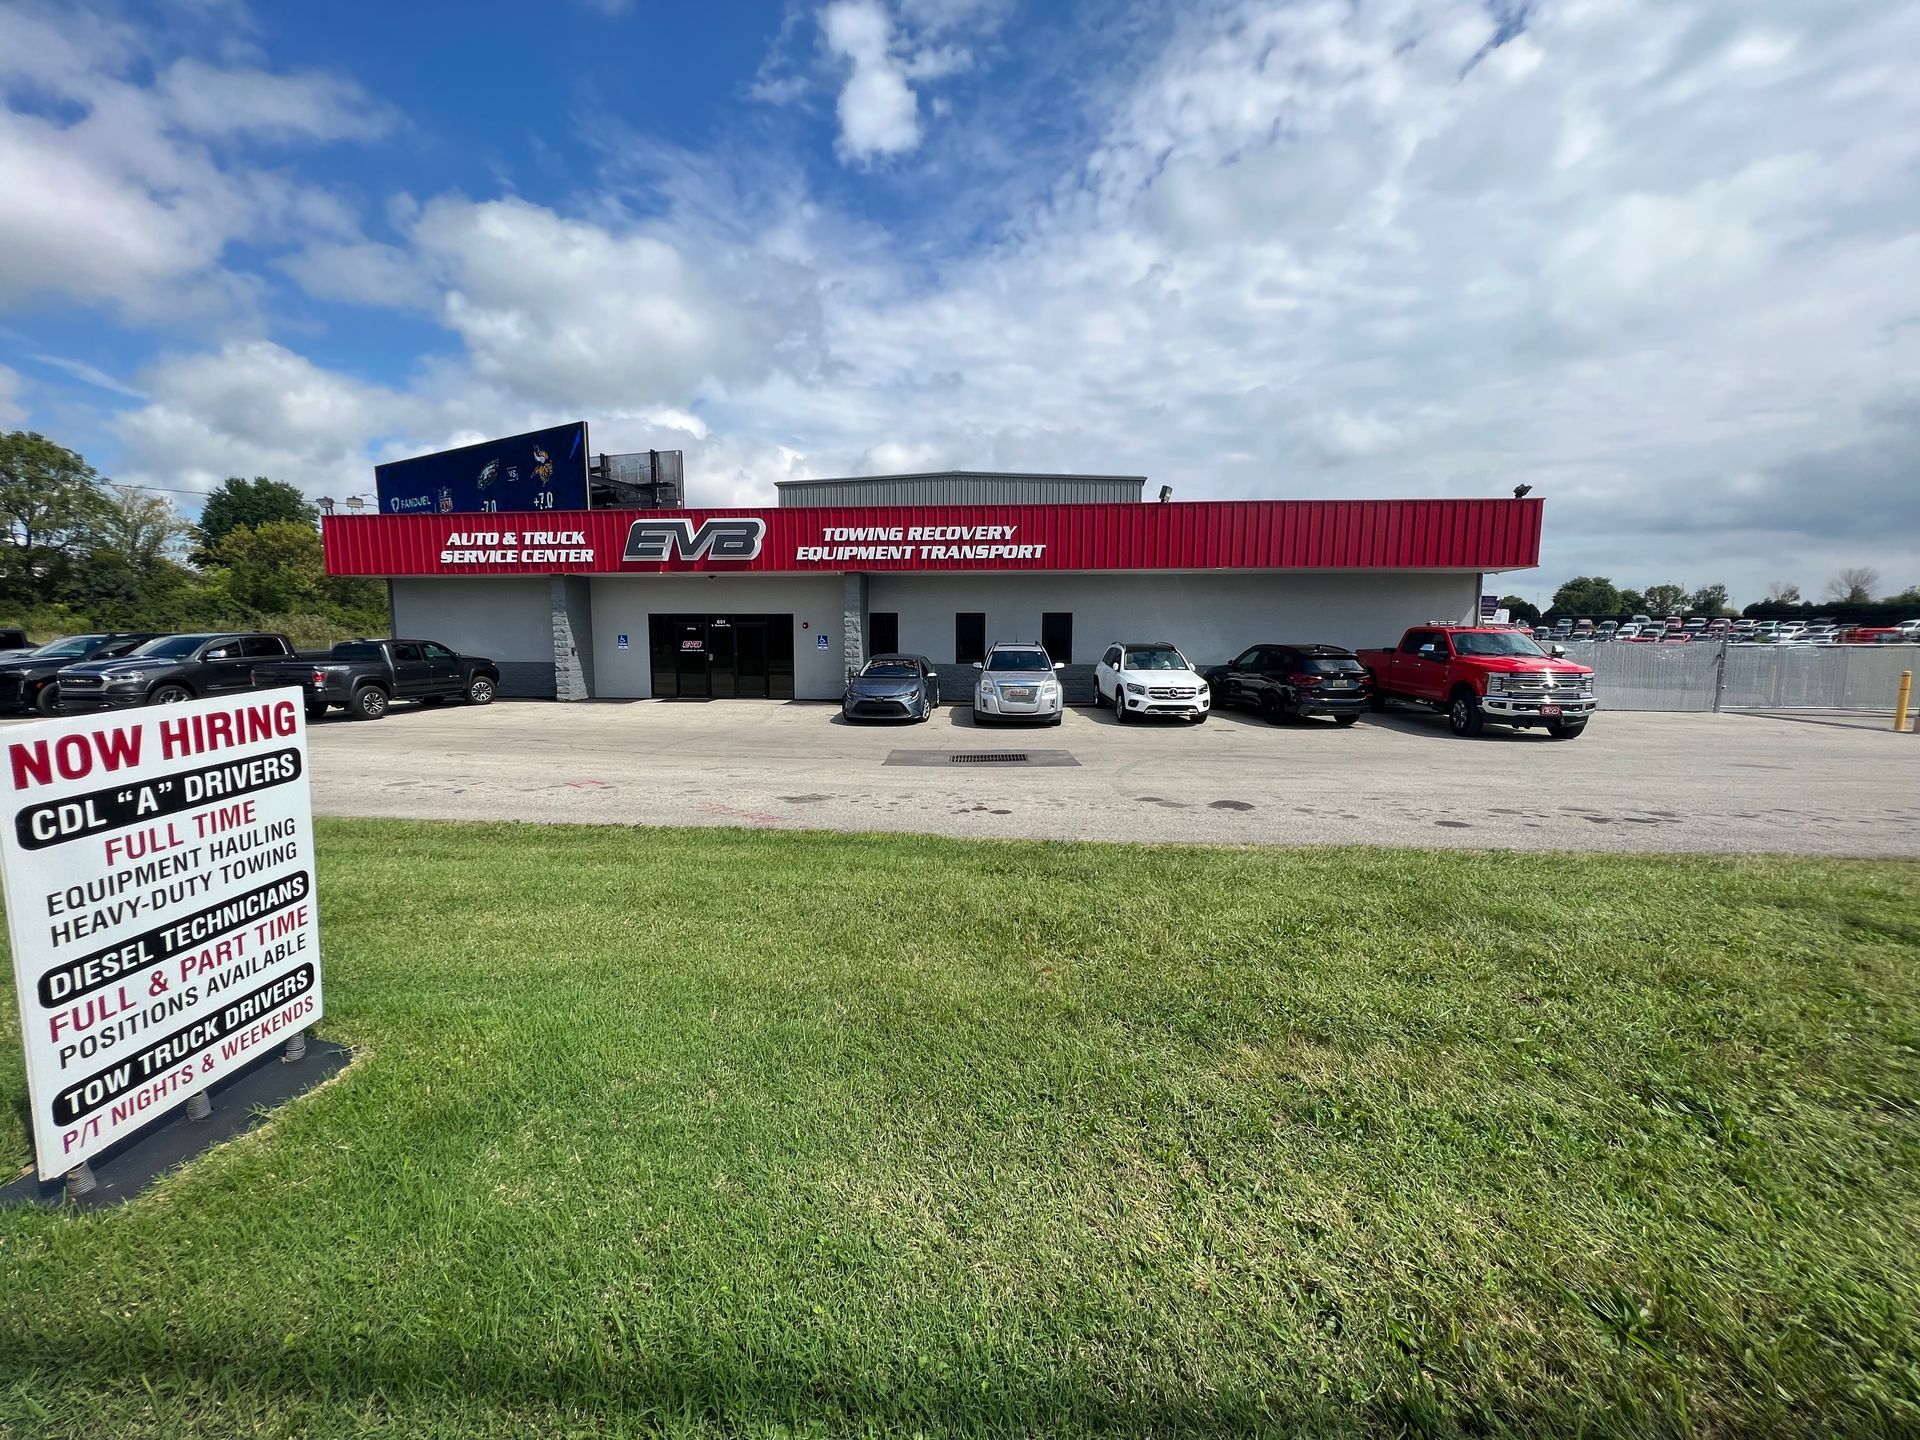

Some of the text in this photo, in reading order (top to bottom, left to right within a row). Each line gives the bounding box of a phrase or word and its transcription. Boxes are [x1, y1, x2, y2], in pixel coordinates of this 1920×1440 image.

[446, 531, 586, 546] AUTO & TRUCK
[481, 500, 497, 512] -70
[533, 491, 553, 509] +7.0
[622, 517, 767, 562] EVB
[823, 526, 1017, 541] TOWING RECOVERY
[440, 549, 594, 564] SERVICE CENTER
[796, 544, 1047, 562] EQUIPMENT TRANSPORT
[9, 701, 297, 790] NOW HIRING
[31, 799, 108, 841] CDL
[184, 753, 295, 802] DRIVERS
[105, 800, 257, 867] FULL TIME
[46, 817, 296, 917] EQUIPMENT HAULING
[51, 841, 297, 947] HEAVY-DUTY TOWING
[50, 877, 304, 1000] DIESEL TECHNICIANS
[50, 905, 308, 1043] FULL & PART TIME
[59, 935, 306, 1069] POSITIONS AVAILABLE
[65, 969, 309, 1115] TOW TRUCK DRIVERS
[63, 996, 314, 1154] P/T NIGHTS & WEEKENDS
